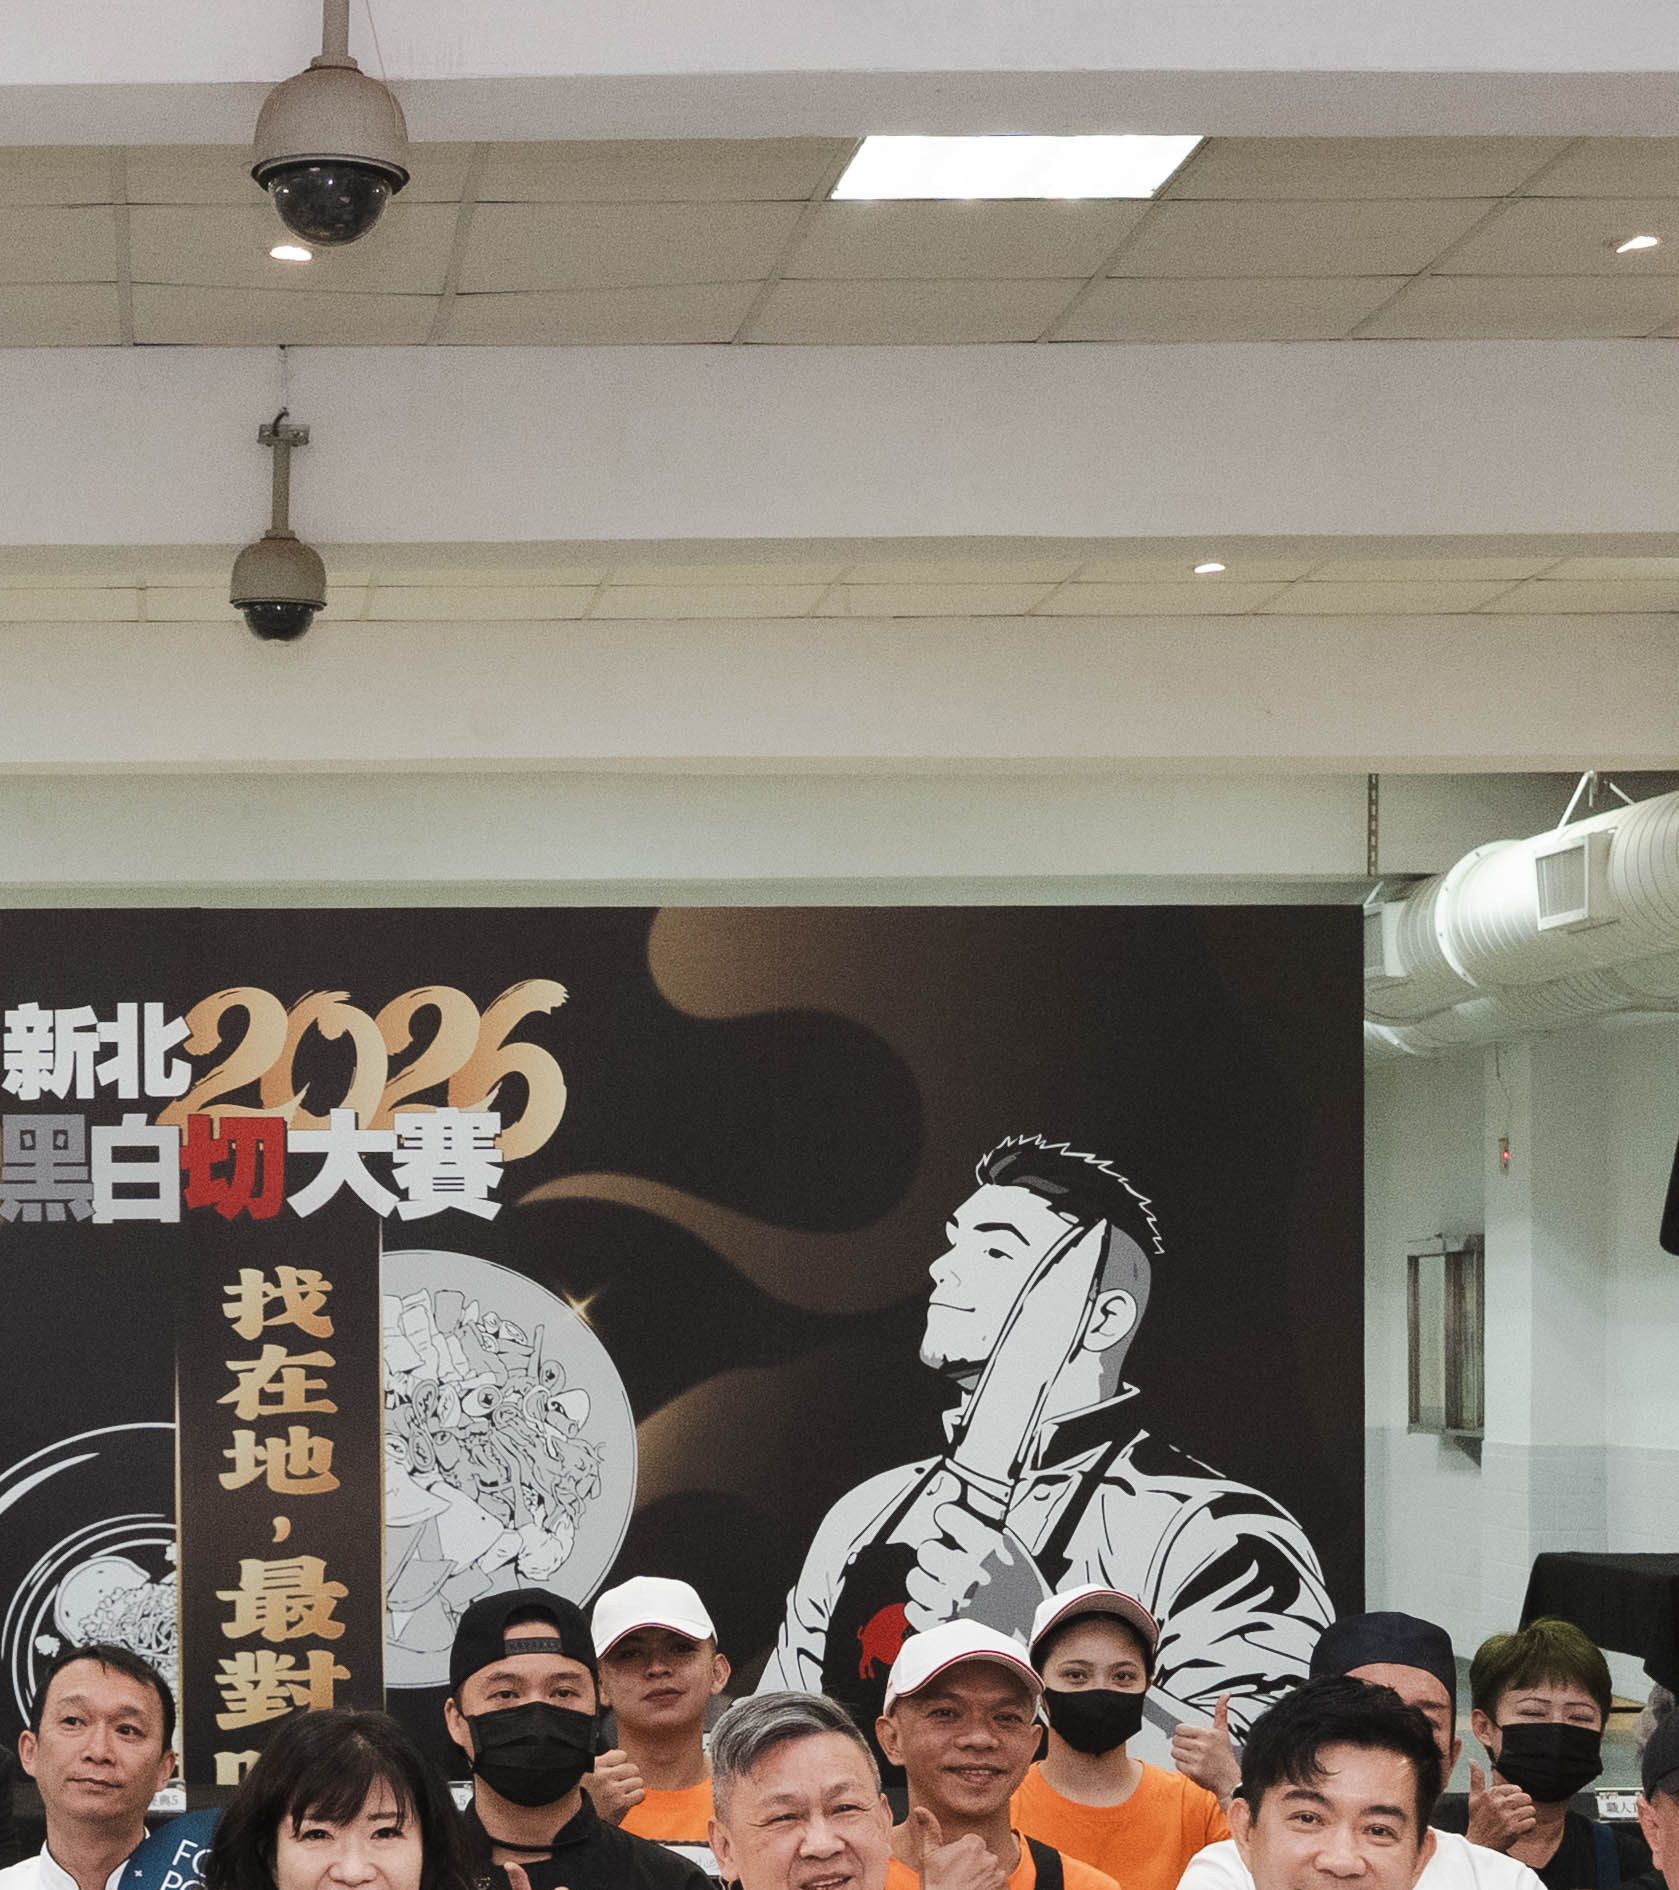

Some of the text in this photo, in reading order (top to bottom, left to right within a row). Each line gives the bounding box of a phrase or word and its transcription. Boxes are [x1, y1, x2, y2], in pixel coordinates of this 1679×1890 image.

[2, 978, 571, 1162] 新北 2026
[215, 1264, 352, 1787] 找在地，最對
